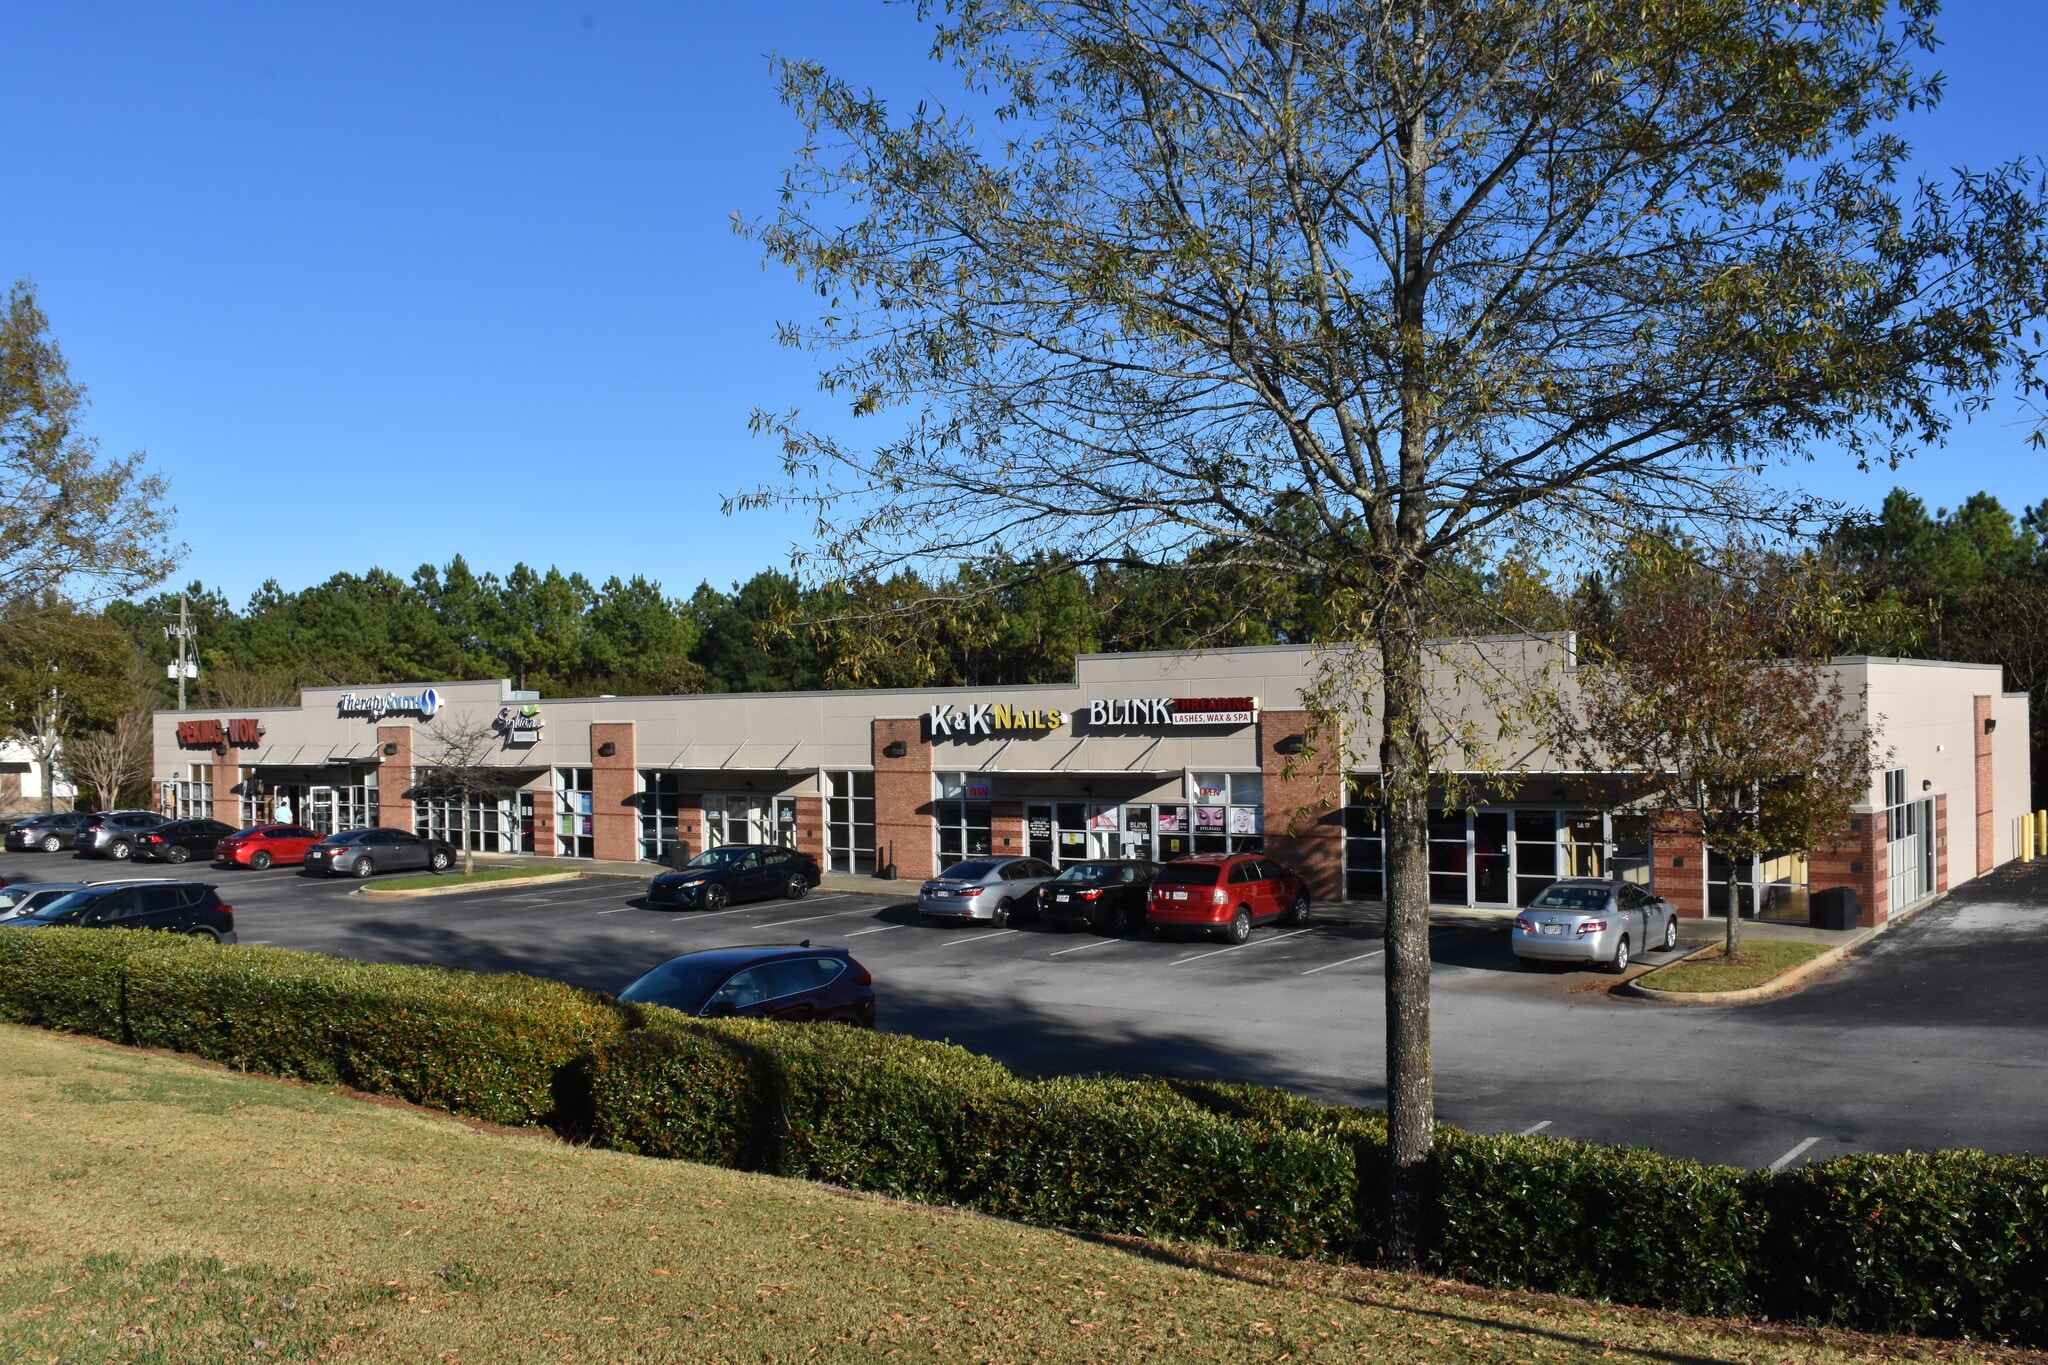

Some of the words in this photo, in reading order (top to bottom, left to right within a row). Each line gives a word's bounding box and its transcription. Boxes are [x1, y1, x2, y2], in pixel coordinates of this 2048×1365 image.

[1089, 698, 1171, 725] BLINK
[1173, 697, 1253, 711] THREADING
[1174, 714, 1206, 723] LASHES,
[1207, 714, 1224, 722] WAX
[1225, 713, 1232, 721] &
[1233, 713, 1249, 721] SPA
[178, 719, 223, 743] PEKING
[228, 719, 259, 742] WOK
